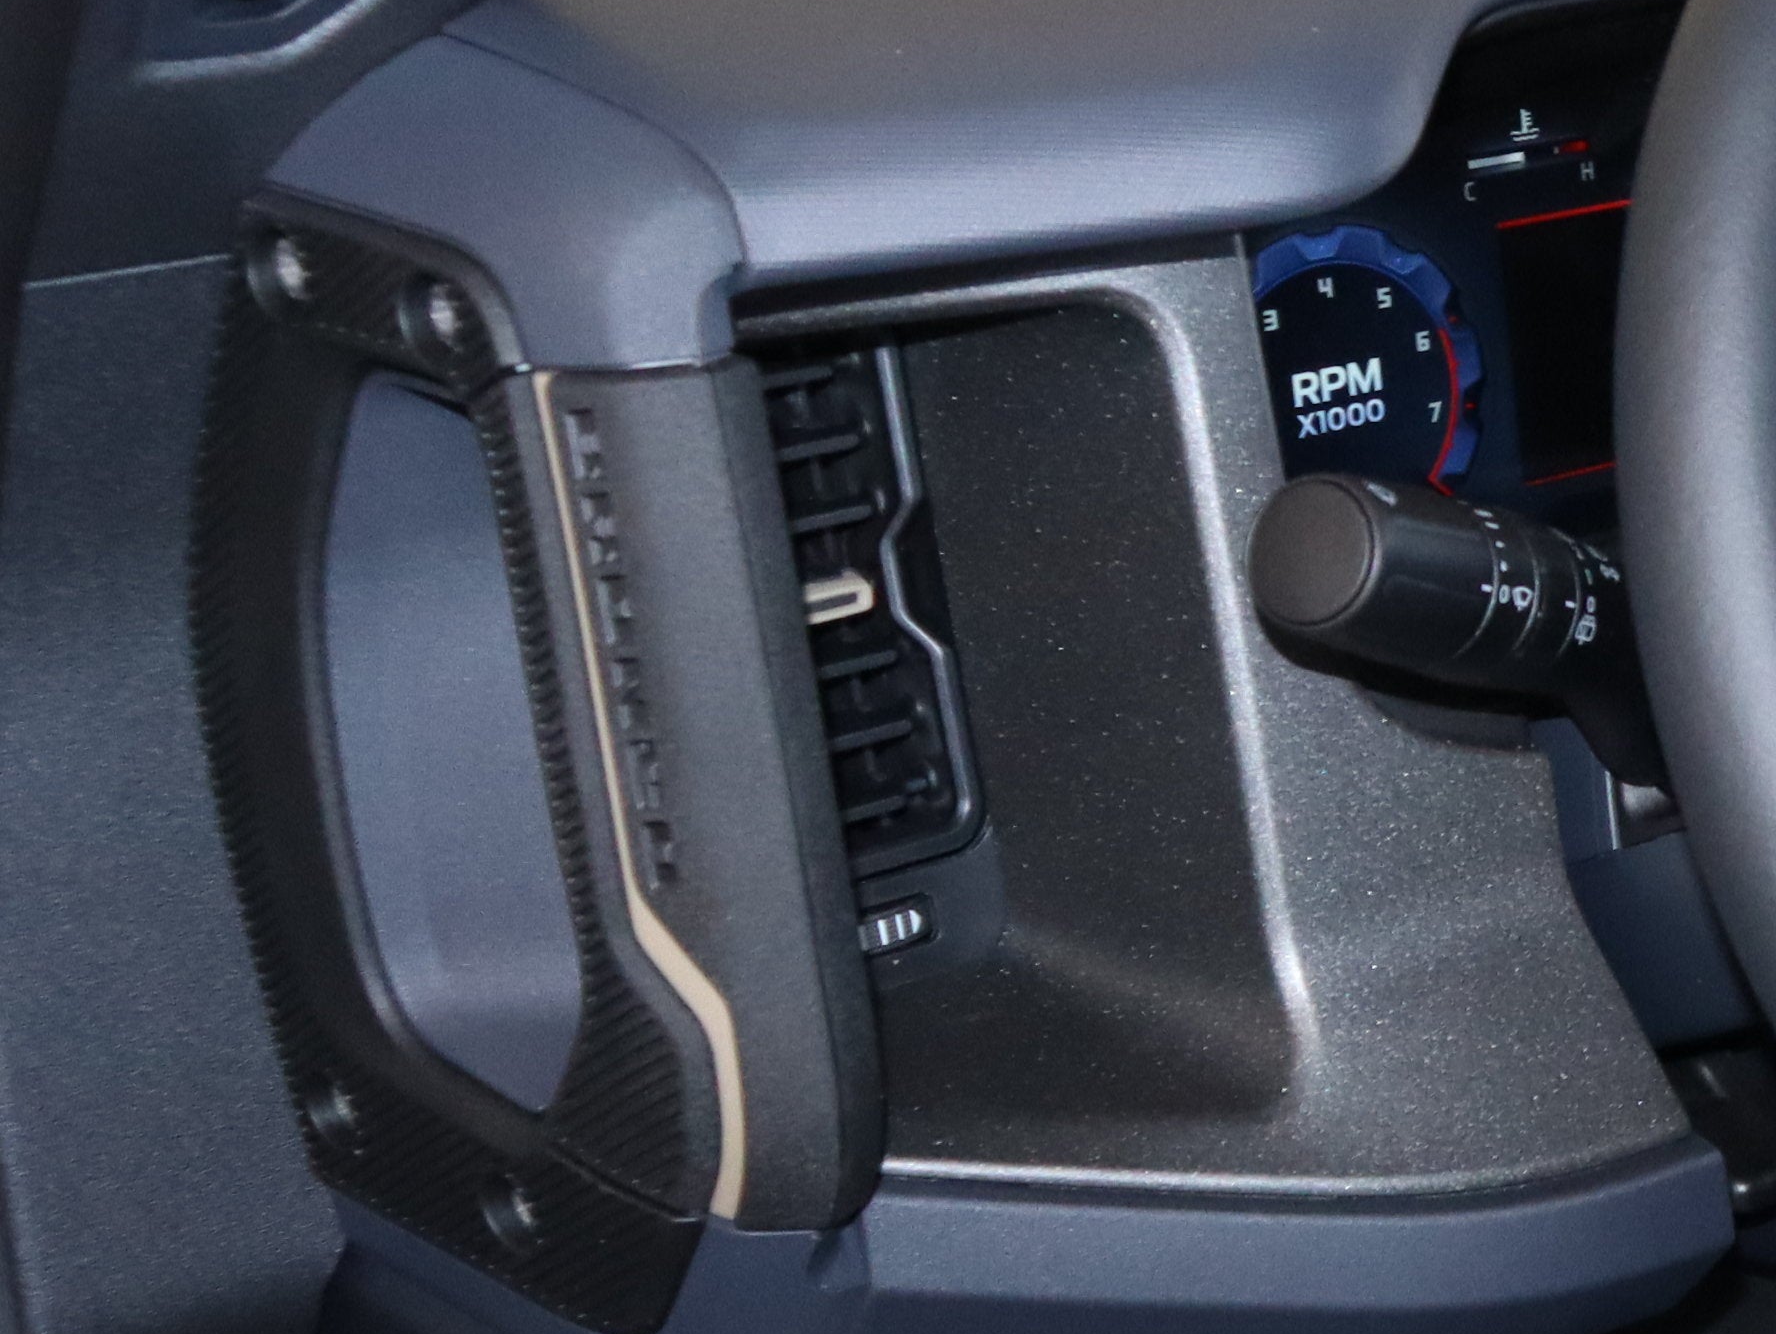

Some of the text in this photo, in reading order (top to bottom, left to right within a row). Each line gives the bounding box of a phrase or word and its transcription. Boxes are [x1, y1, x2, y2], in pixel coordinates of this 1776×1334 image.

[1579, 160, 1595, 181] H
[1463, 181, 1477, 202] C
[1317, 277, 1335, 299] 4
[1376, 287, 1393, 309] 5
[1262, 309, 1280, 332] 3
[1414, 330, 1431, 352] 6
[1291, 357, 1384, 408] RPM
[1296, 398, 1386, 439] X1000
[1427, 401, 1443, 423] 7
